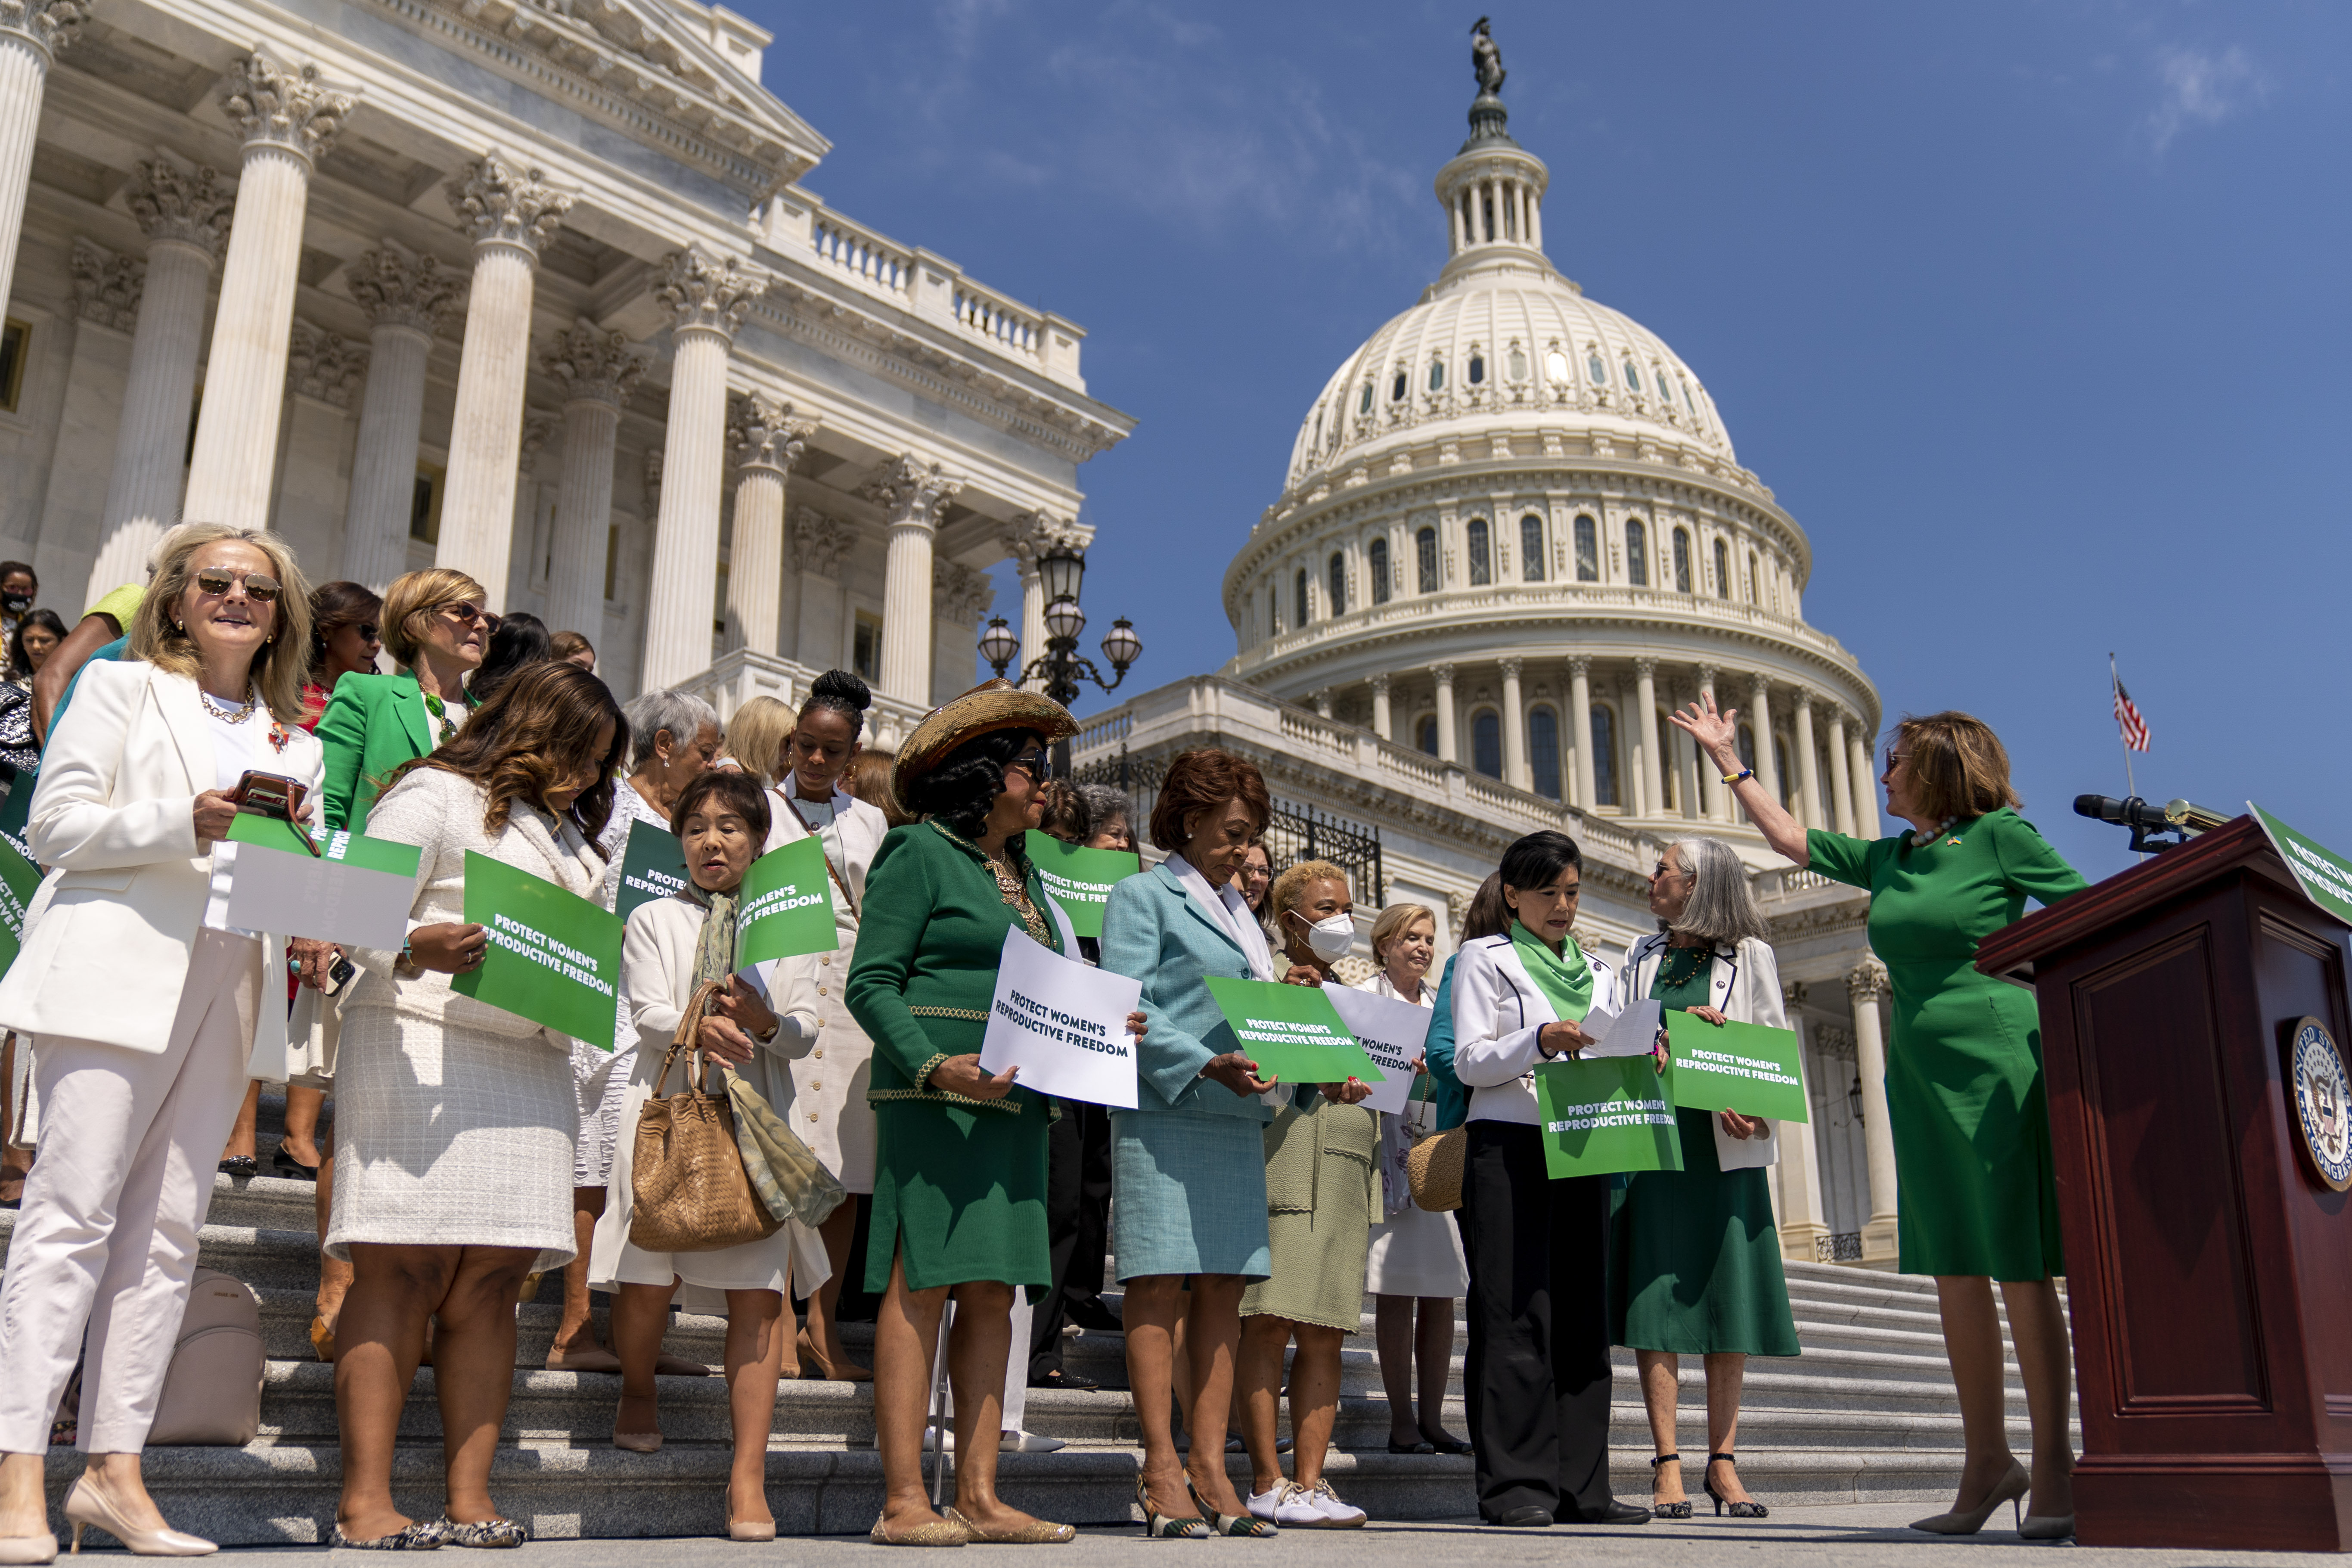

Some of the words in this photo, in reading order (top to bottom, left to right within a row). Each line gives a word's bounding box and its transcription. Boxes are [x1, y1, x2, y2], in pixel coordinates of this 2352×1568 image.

[2286, 837, 2344, 882] PROTECT
[625, 875, 677, 897] REPROD
[647, 869, 687, 890] PROTE
[1039, 868, 1071, 888] PROTECT
[740, 885, 796, 920] WOMEN'S
[754, 893, 823, 921] FREEDOM
[1088, 894, 1109, 903] FRE
[495, 913, 546, 947] PROTECT
[548, 938, 598, 972] WOMEN'S
[472, 922, 561, 972] EPRODUCTIVE
[563, 963, 612, 997] FREEDOM
[1010, 989, 1048, 1018] PROTECT
[1051, 1009, 1105, 1037] WOMEN'S
[996, 999, 1064, 1041] REPRODUCTIVE
[1066, 1032, 1128, 1057] FREEDOM
[1246, 1018, 1288, 1031] PROTECT
[1286, 1022, 1331, 1034] WOMEN'S
[1238, 1030, 1310, 1045] REPRODUCTIVE
[1307, 1036, 1355, 1046] FREEDOM
[1362, 1038, 1403, 1056] WOMEN'S
[1371, 1054, 1412, 1072] FREEDOM
[1692, 1049, 1734, 1064] PROTECT
[1736, 1056, 1781, 1071] WOMEN'S
[2297, 1027, 2315, 1091] UNITED
[2318, 1030, 2351, 1107] STATES
[1676, 1058, 1750, 1078] REPRODUCTIVE
[1752, 1070, 1798, 1086] FREEDOM
[1568, 1101, 1622, 1116] PROTECT
[1624, 1099, 1666, 1111] WOMEN'S
[1548, 1114, 1641, 1133] REPRODUCTIVE
[1644, 1114, 1675, 1125] FREEDOM
